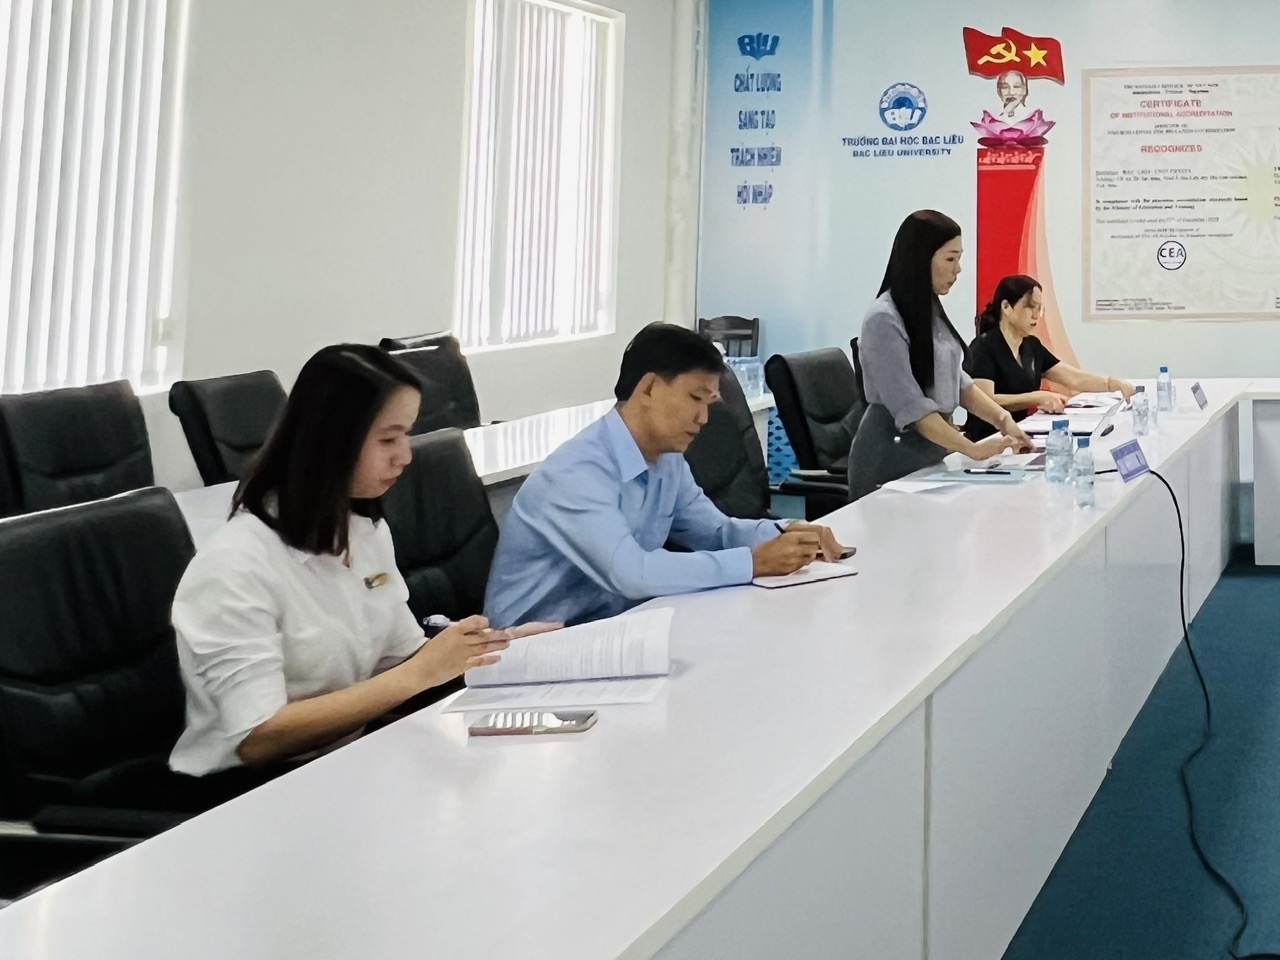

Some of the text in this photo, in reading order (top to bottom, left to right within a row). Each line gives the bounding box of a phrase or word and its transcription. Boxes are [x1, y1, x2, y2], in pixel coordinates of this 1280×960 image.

[737, 32, 780, 60] BLU
[1139, 99, 1202, 109] CERTIFICATE
[853, 149, 871, 157] BAC
[896, 148, 952, 156] UNIVERSITY
[1159, 247, 1185, 258] CEA
